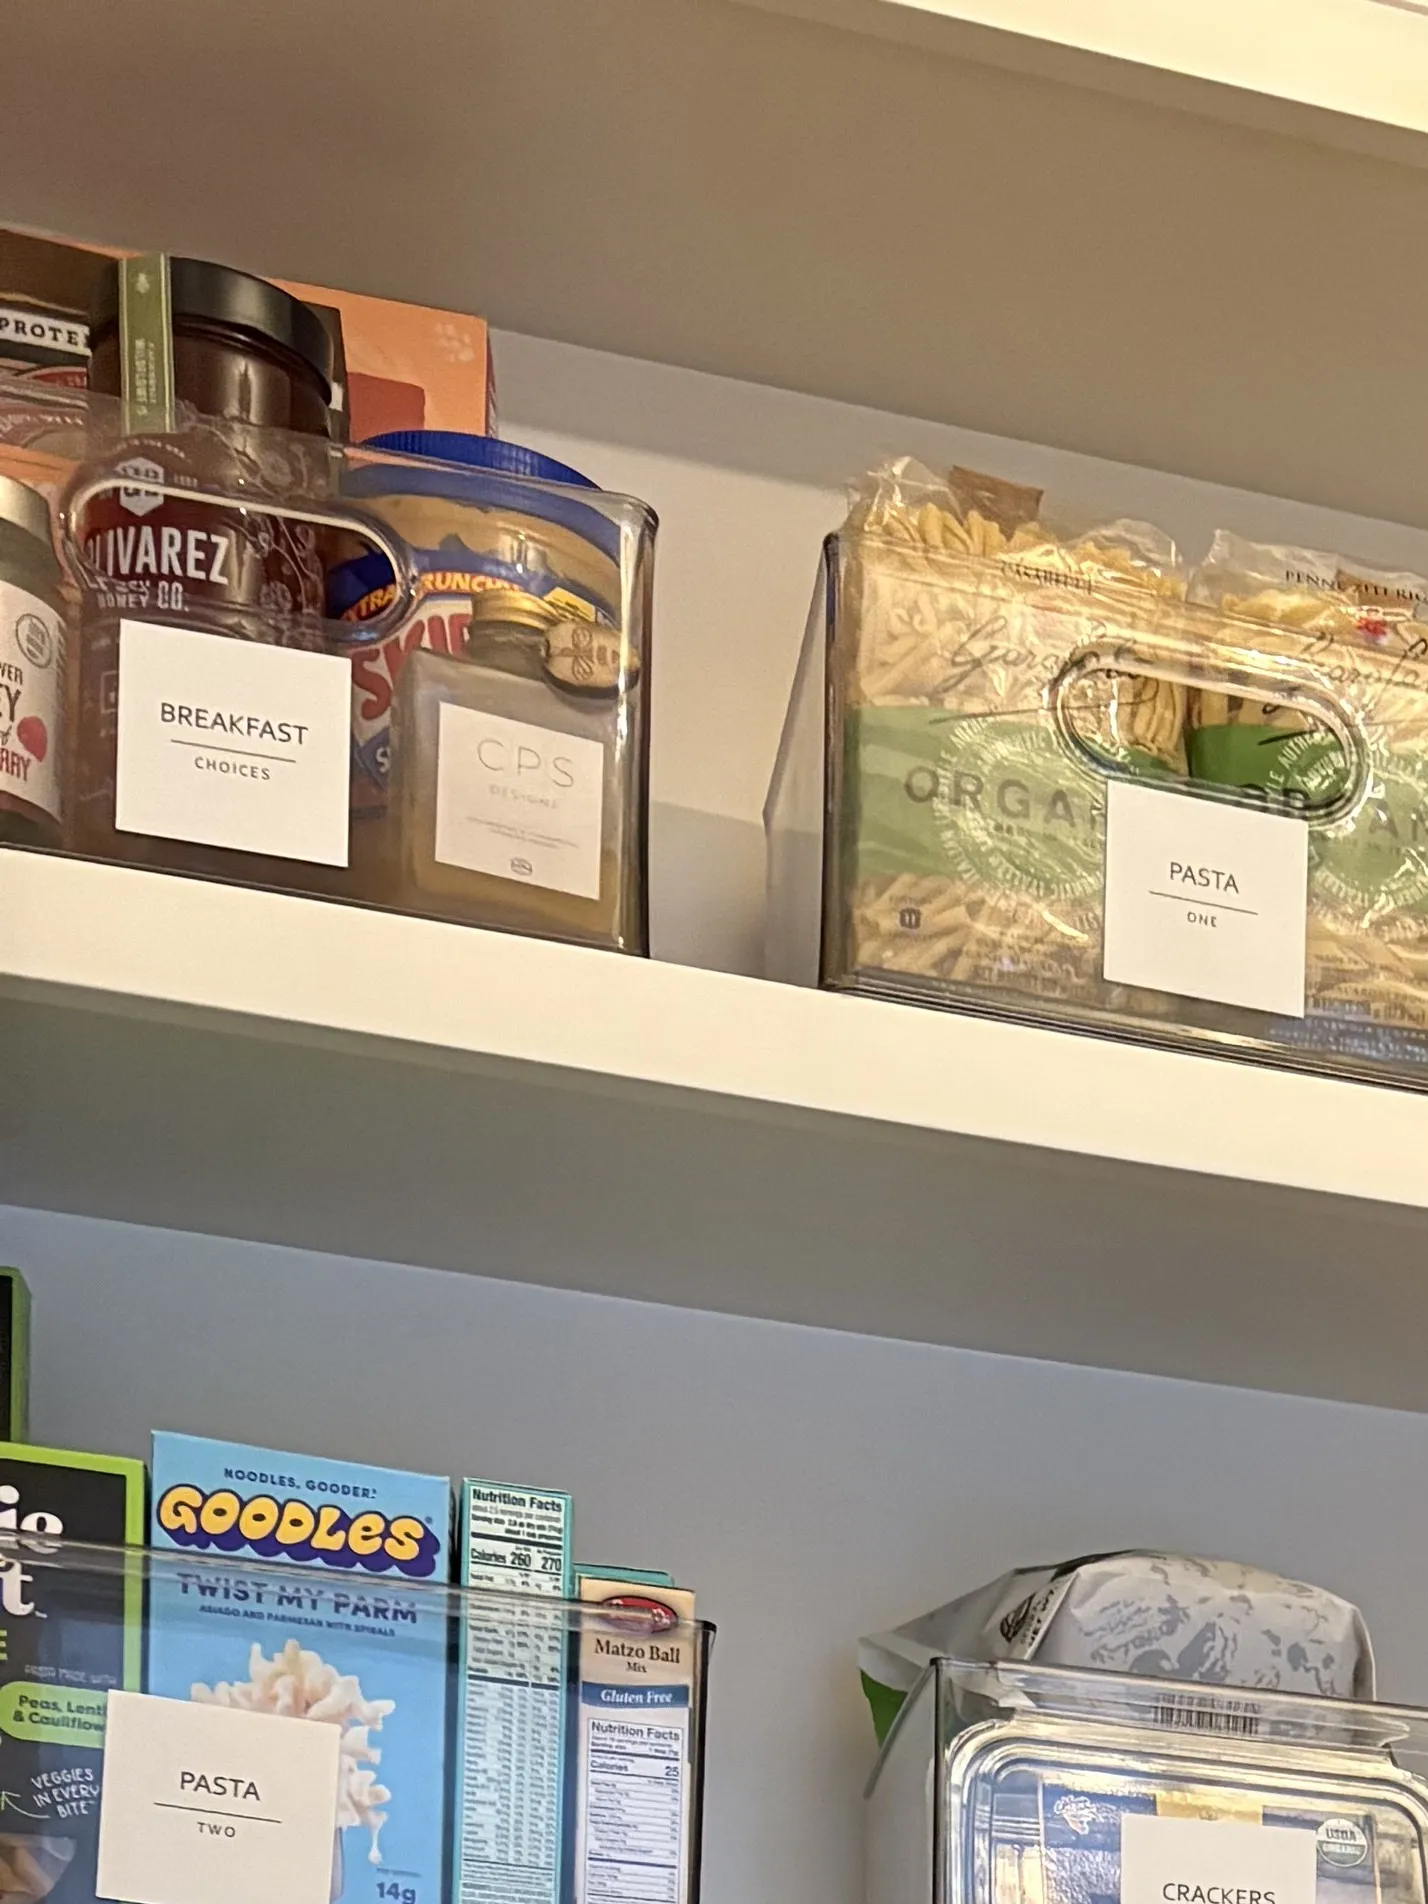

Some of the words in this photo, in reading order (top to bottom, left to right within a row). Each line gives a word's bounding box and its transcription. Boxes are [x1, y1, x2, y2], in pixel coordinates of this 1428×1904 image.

[160, 702, 310, 746] BREAKFAST
[194, 756, 271, 781] CHOICES
[477, 738, 575, 788] CPS
[1169, 860, 1240, 896] PASTA
[1187, 910, 1218, 929] ONE
[472, 1488, 526, 1508] Nutrition
[529, 1496, 562, 1512] Facts
[157, 1484, 432, 1566] GOODLES
[471, 1549, 507, 1564] Calories
[510, 1551, 532, 1568] 260
[541, 1555, 562, 1572] 270
[177, 1571, 269, 1603] TWIST
[276, 1583, 326, 1609] MY
[333, 1590, 418, 1624] PARM
[594, 1638, 645, 1660] Matzo
[650, 1645, 681, 1664] Ball
[626, 1661, 648, 1674] Mix
[600, 1689, 645, 1704] Gluten
[647, 1691, 674, 1703] Free
[591, 1721, 644, 1737] Nutrition
[645, 1727, 680, 1741] Facts
[31, 1767, 94, 1789] VEGGIES
[664, 1765, 680, 1778] 25
[32, 1790, 51, 1807] IN
[51, 1784, 100, 1805] EVERY
[180, 1771, 261, 1802] PASTA
[57, 1800, 89, 1818] BITE
[197, 1821, 237, 1839] TWO
